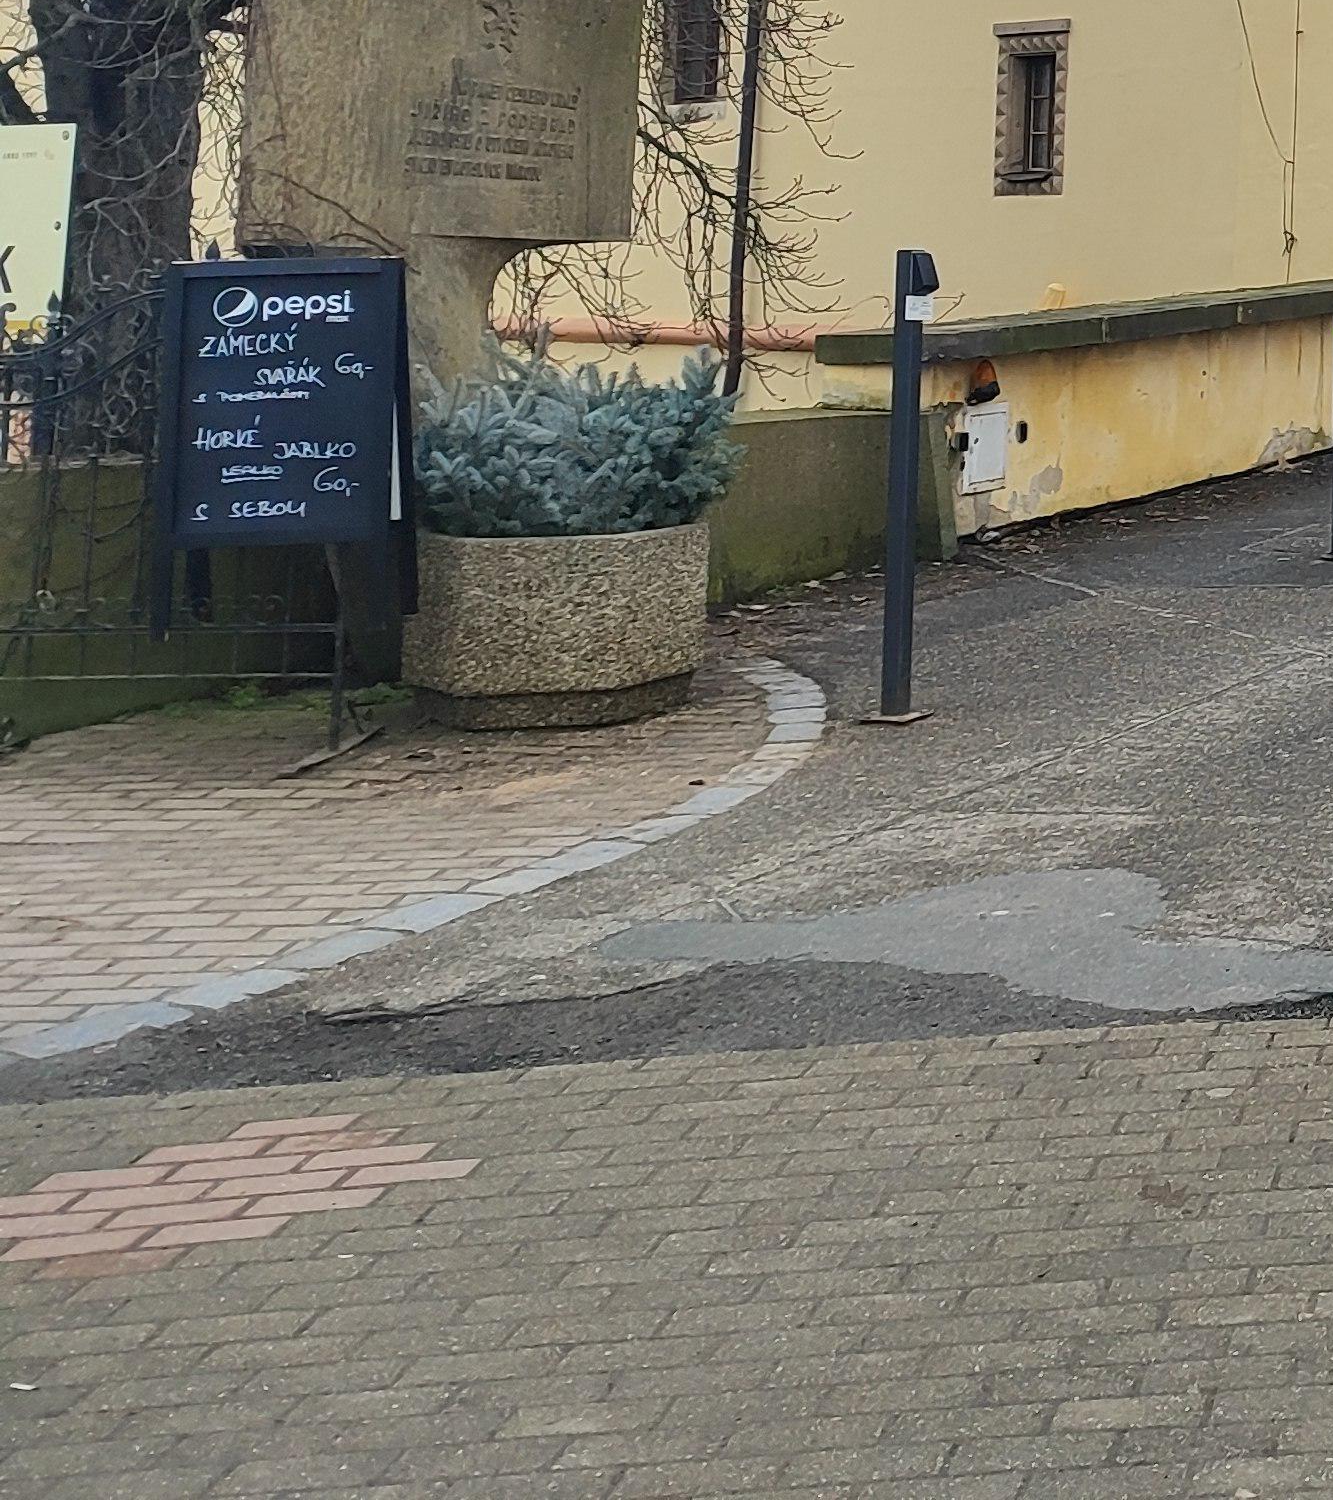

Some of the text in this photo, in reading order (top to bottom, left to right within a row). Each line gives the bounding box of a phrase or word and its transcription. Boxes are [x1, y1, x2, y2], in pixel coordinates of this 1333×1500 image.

[262, 289, 355, 322] pepsi
[198, 322, 299, 358] ZÁMECKÝ
[191, 414, 357, 460] HORKÉ JABLKO
[190, 500, 307, 521] S SEBOU
